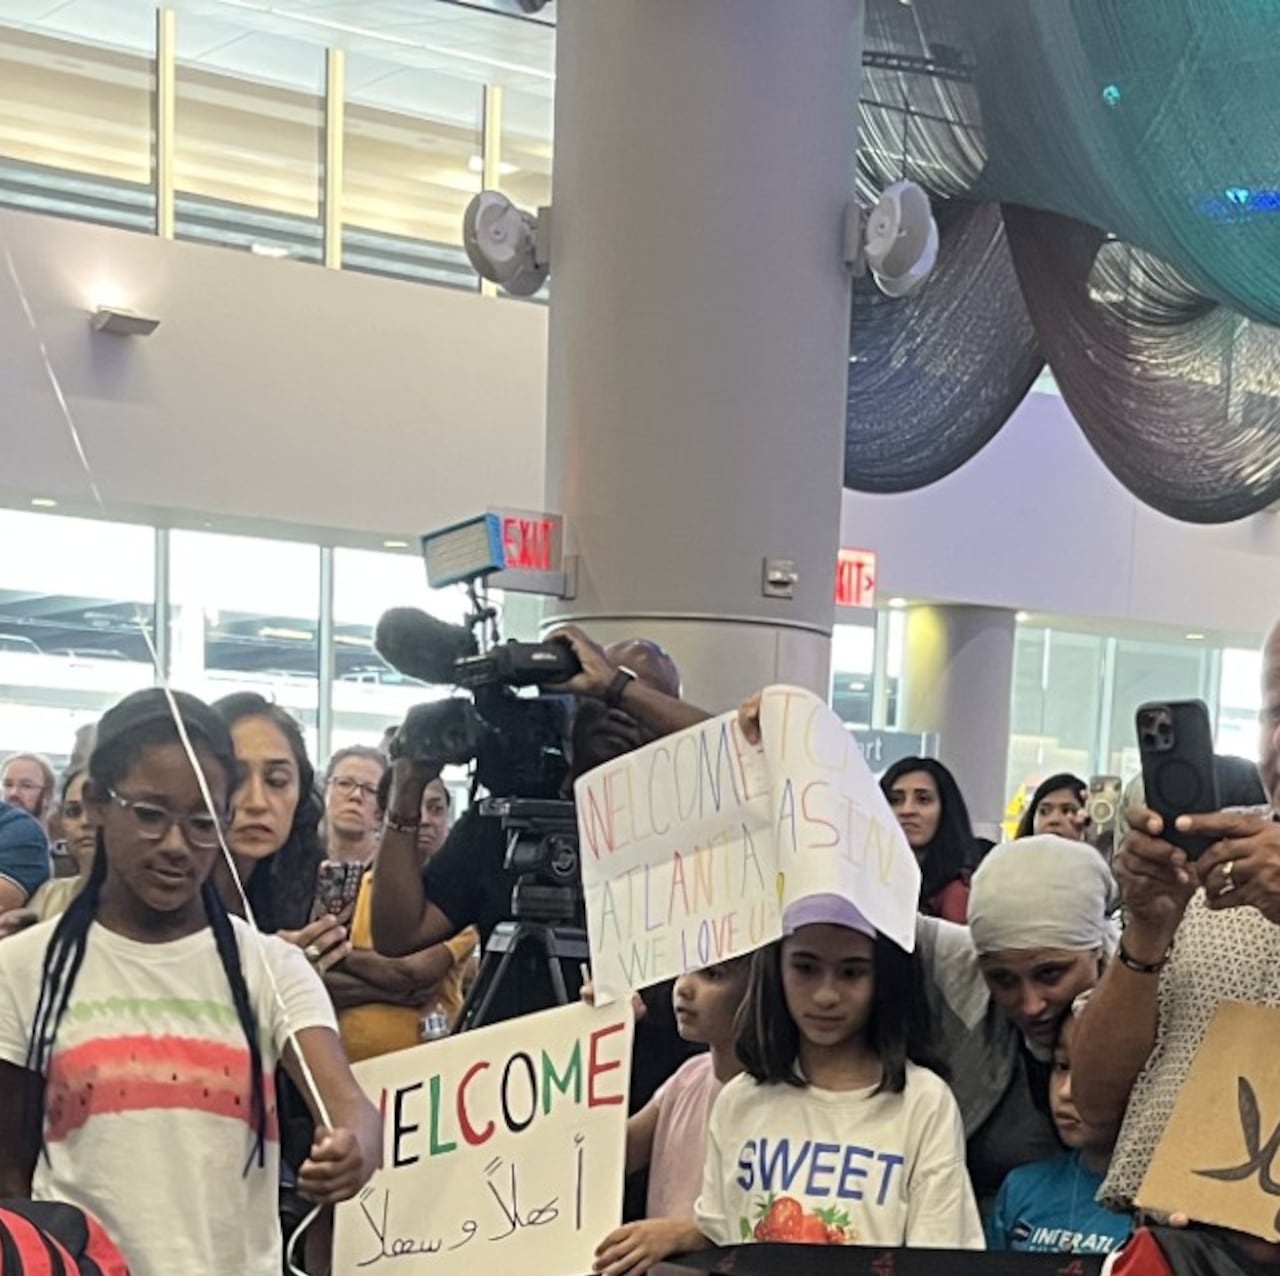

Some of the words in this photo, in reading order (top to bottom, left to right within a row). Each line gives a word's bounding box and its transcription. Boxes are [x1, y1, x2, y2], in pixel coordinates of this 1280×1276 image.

[503, 518, 552, 570] EXIT
[585, 719, 770, 861] WELCOME
[766, 692, 848, 770] TO
[598, 822, 765, 952] ATLANTA
[617, 940, 669, 988] WE
[681, 913, 738, 971] LOVE
[737, 1138, 904, 1206] SWEET
